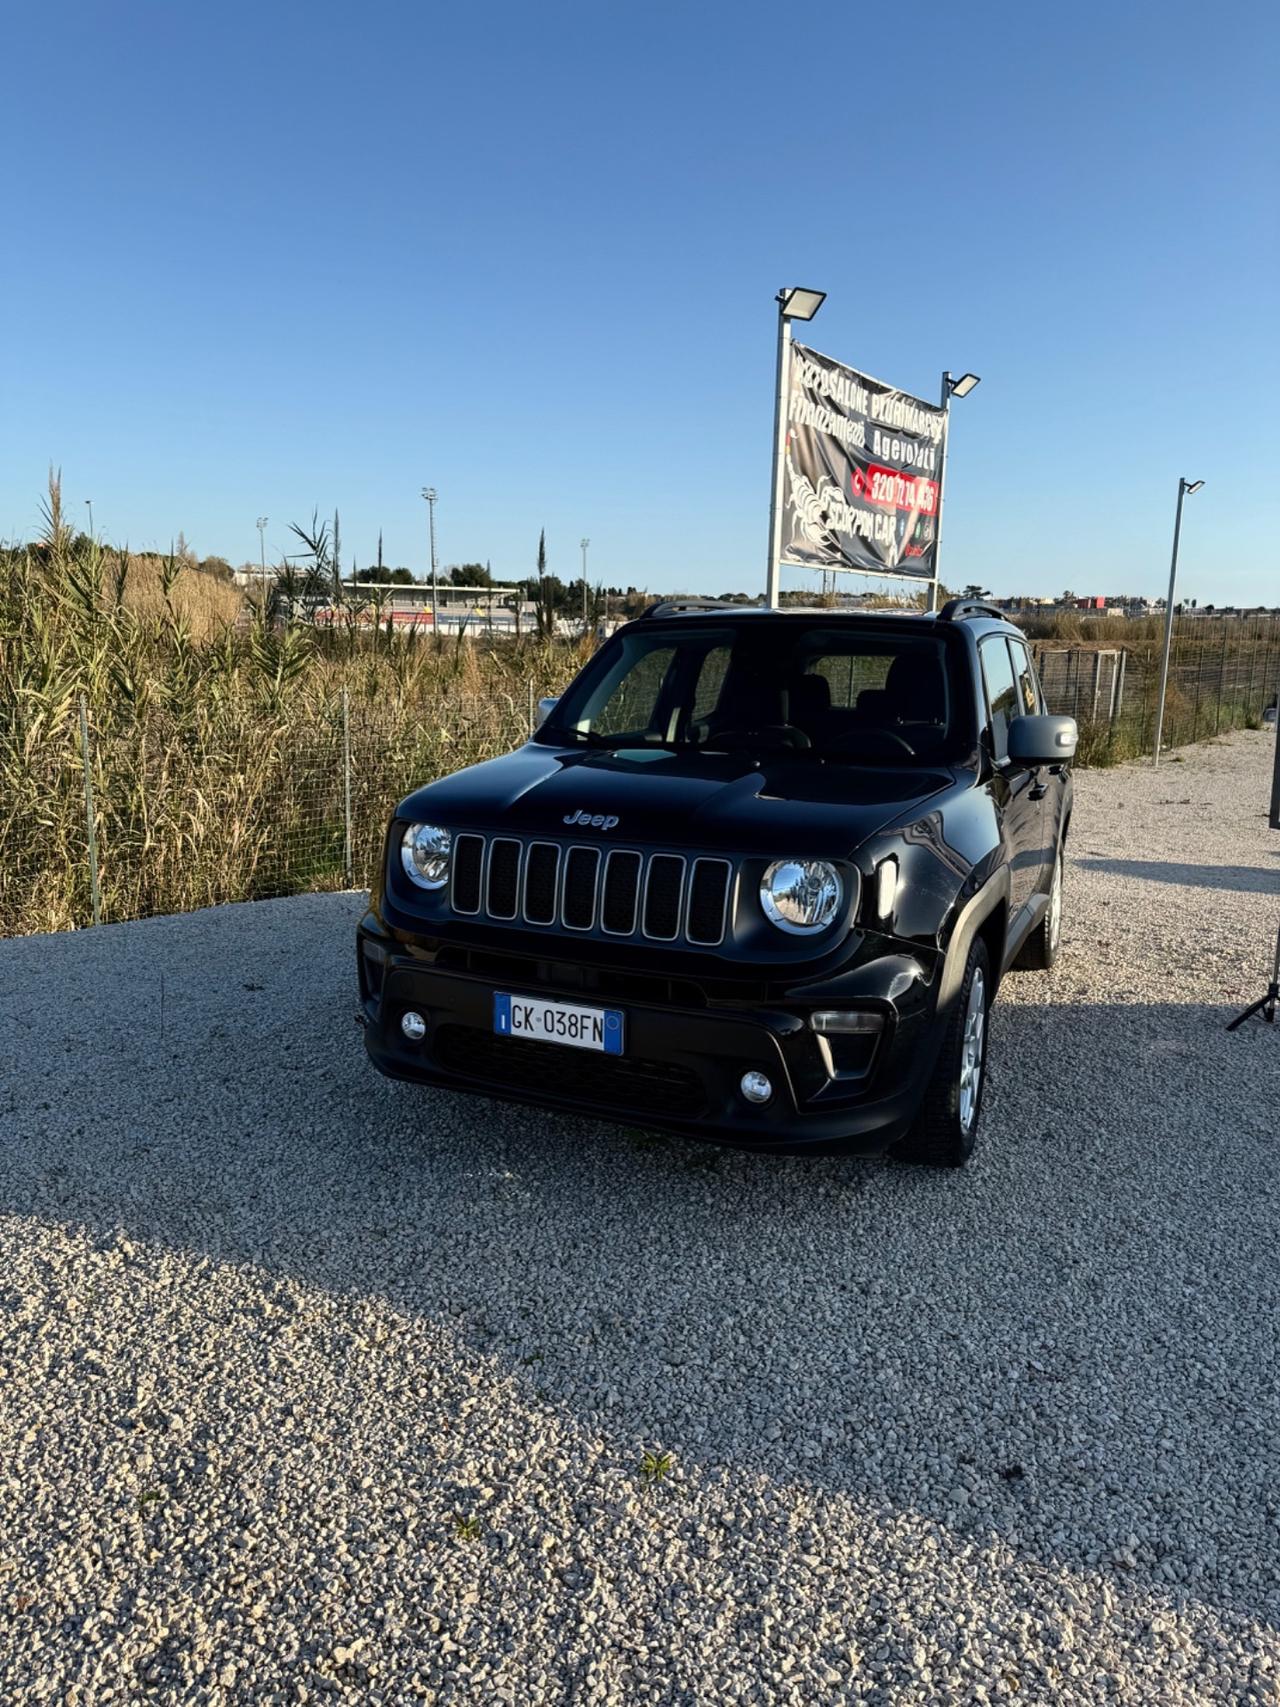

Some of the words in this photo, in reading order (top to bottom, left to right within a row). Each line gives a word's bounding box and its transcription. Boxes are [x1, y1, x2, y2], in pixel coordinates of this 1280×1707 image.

[873, 429, 935, 471] Agevolati
[871, 471, 895, 502] 320
[874, 513, 896, 549] CAR
[563, 809, 620, 830] Jeep
